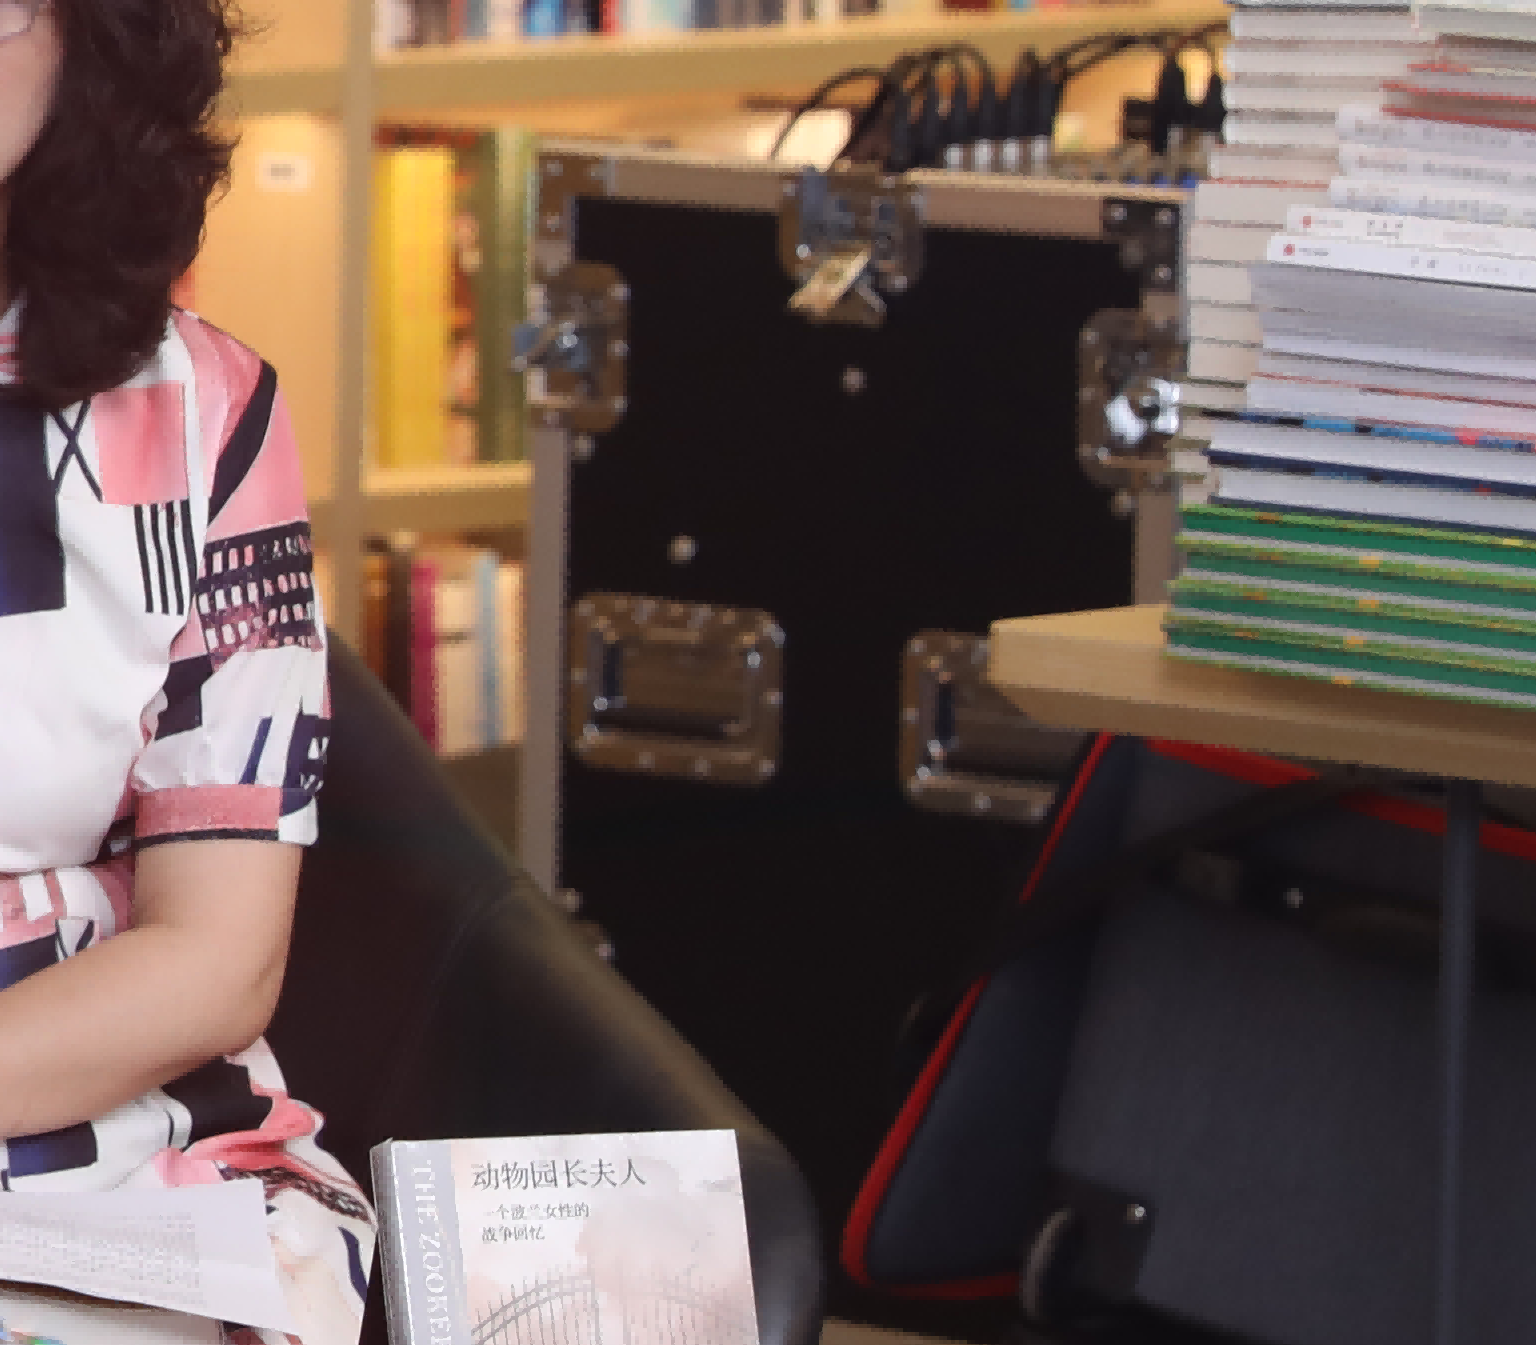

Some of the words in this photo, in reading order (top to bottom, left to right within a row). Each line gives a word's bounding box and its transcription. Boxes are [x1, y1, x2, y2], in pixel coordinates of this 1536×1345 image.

[471, 1158, 647, 1191] 动物园长夫人
